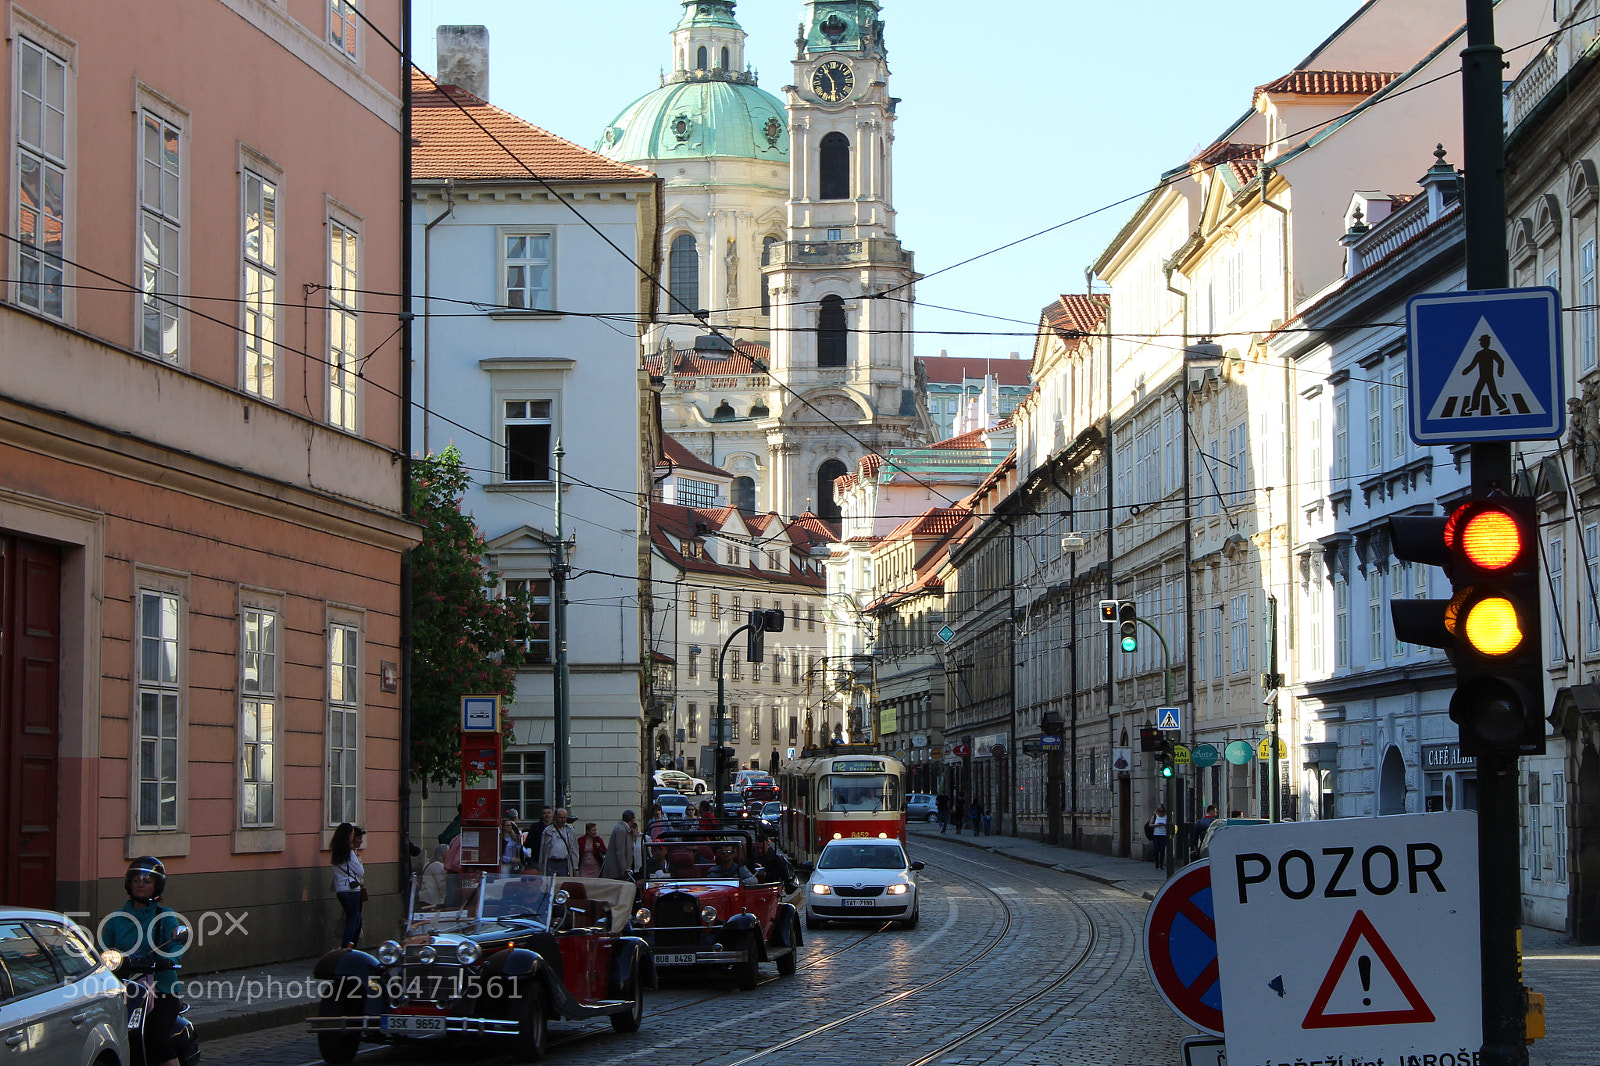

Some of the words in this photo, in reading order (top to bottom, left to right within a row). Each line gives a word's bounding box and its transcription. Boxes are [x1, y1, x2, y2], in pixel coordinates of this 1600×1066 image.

[1428, 745, 1449, 765] CAFÉ
[1235, 842, 1447, 904] POZOR
[415, 1018, 441, 1030] 9652
